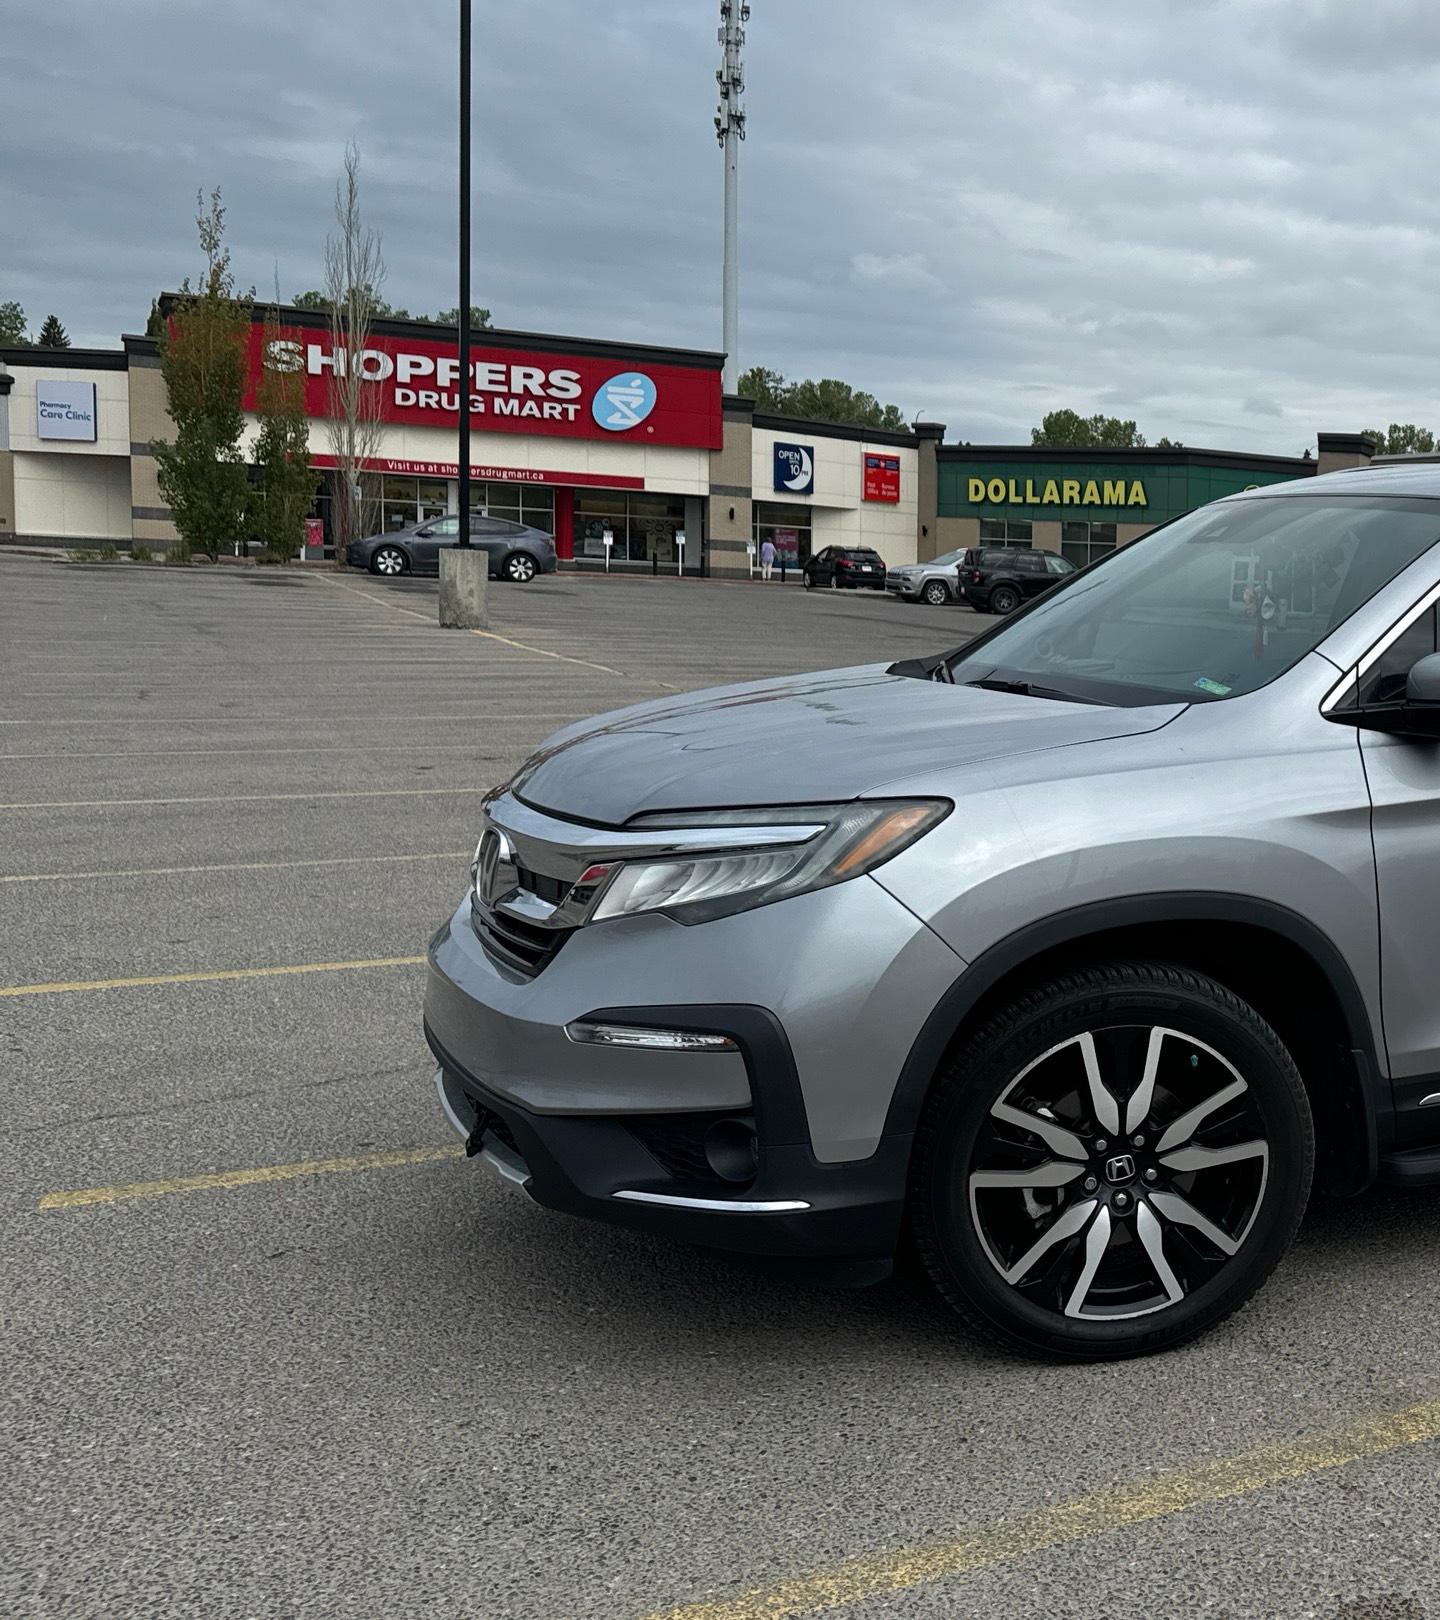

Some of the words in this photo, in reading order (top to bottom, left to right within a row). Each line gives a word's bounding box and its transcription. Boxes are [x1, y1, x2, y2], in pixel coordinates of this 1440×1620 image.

[263, 340, 582, 400] SHOPPERS
[40, 401, 71, 409] Pharmacy
[395, 388, 485, 413] DRUG
[493, 397, 581, 421] MART
[40, 409, 63, 419] Care
[66, 411, 91, 421] Clinic
[778, 450, 800, 461] OPEN
[387, 460, 410, 471] Visit
[413, 464, 425, 472] us
[428, 464, 437, 473] at
[441, 465, 544, 480] shoersdrugmart.ca
[790, 464, 800, 476] 10
[968, 478, 1147, 505] DOLLARAMA
